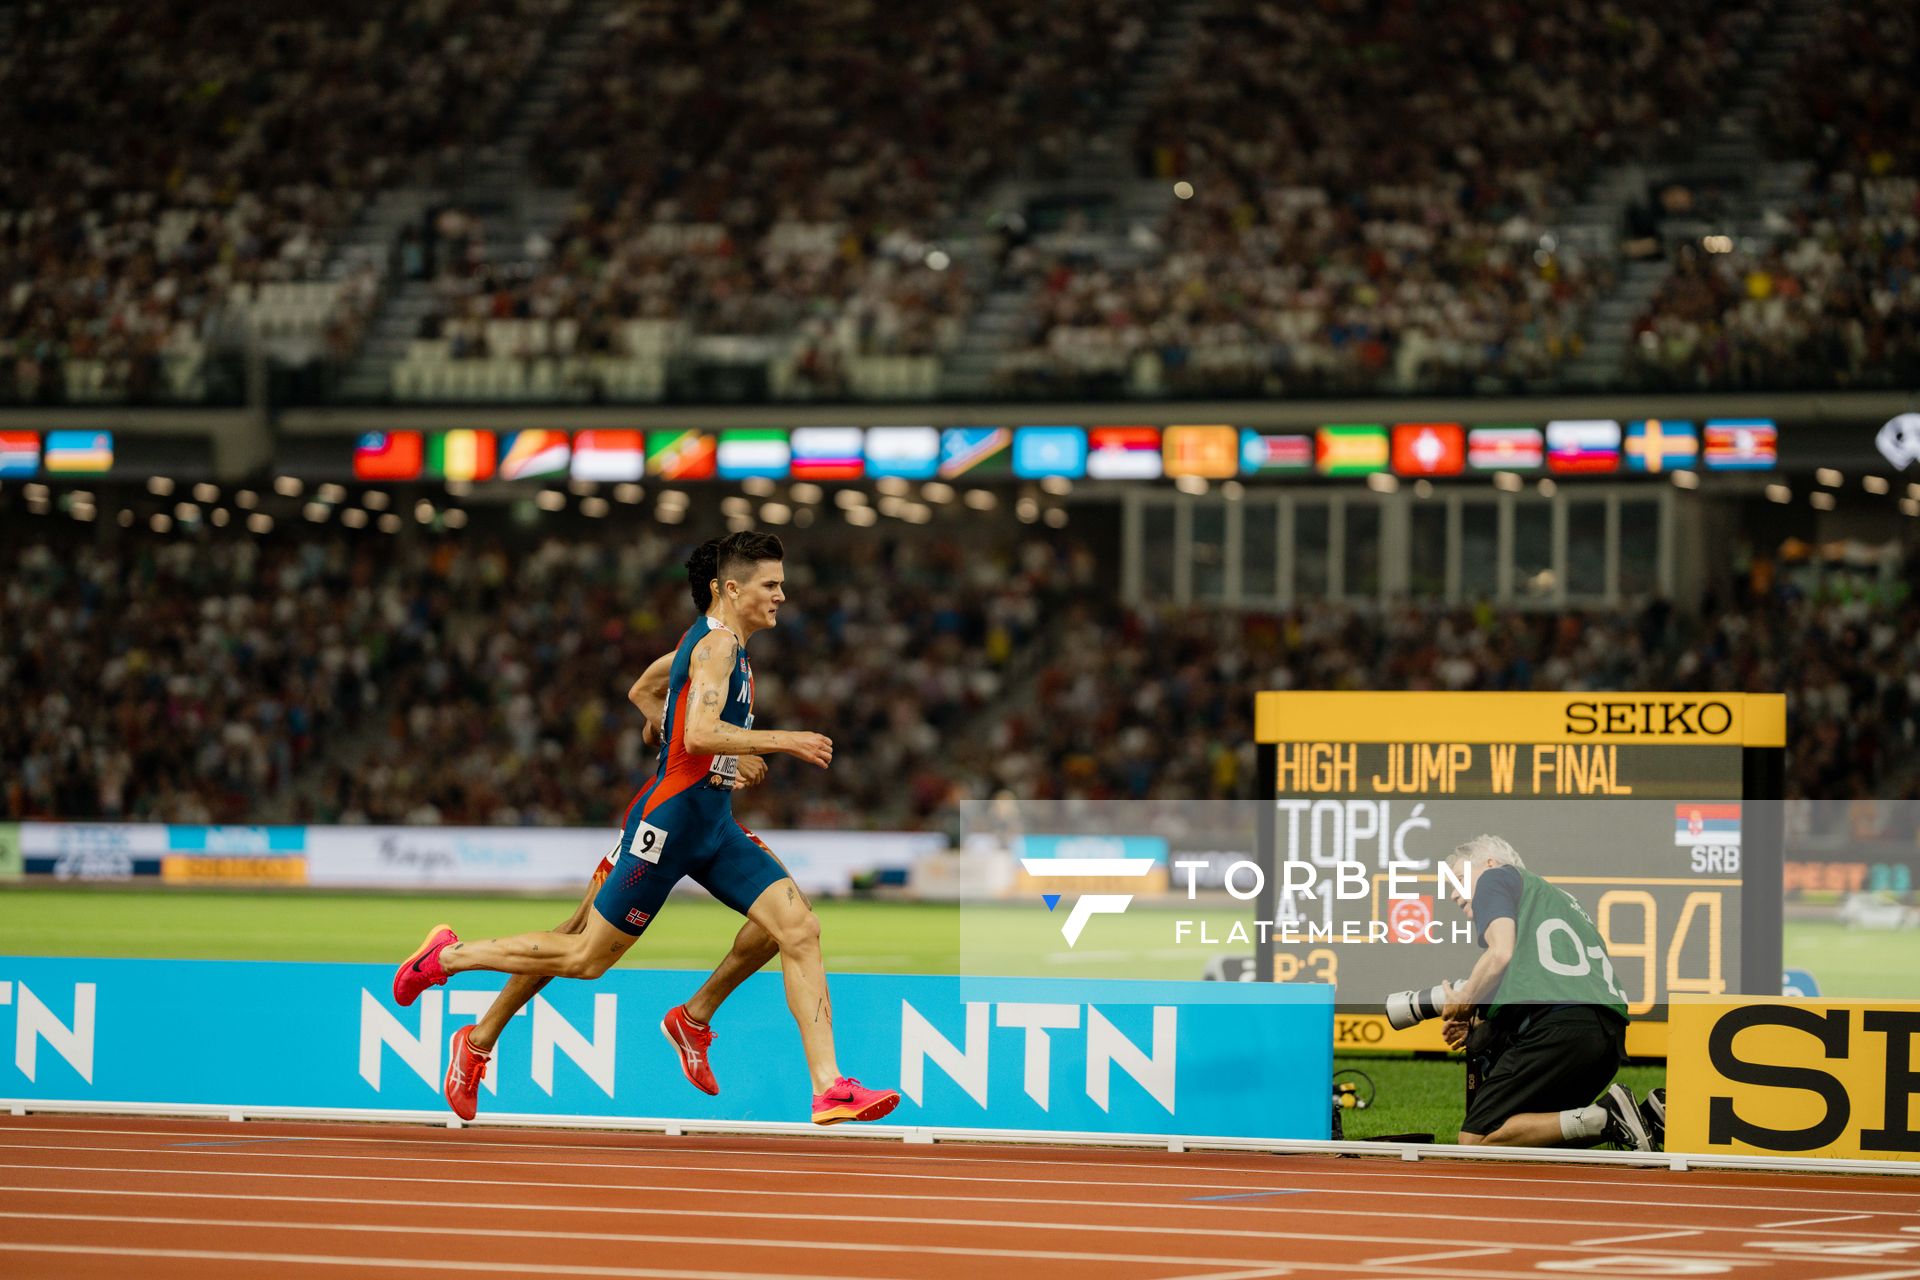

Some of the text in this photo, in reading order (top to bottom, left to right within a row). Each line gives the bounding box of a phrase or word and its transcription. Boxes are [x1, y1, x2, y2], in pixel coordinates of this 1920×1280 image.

[1565, 701, 1733, 736] SEIKO
[1276, 743, 1632, 796] HIGH JUMP W FINAL
[640, 830, 656, 854] 9
[1690, 845, 1741, 874] SRB
[0, 980, 97, 1085] N
[359, 987, 618, 1099] NTN
[900, 998, 1178, 1117] NTN
